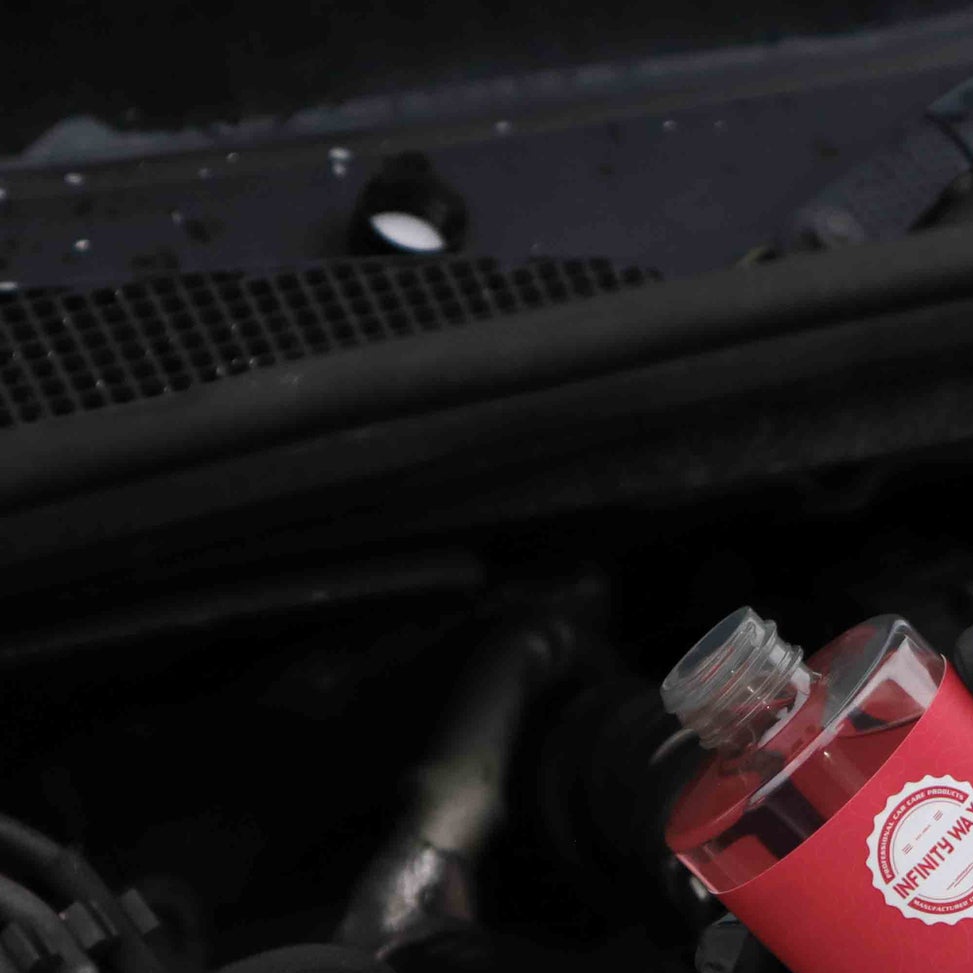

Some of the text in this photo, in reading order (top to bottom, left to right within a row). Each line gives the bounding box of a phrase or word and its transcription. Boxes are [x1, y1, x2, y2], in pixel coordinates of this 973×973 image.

[880, 821, 894, 879] PROFESSIONAL
[893, 805, 906, 820] CAR
[906, 792, 925, 806] CARE
[927, 788, 964, 801] PRODUCTS
[892, 836, 955, 900] INFINITY
